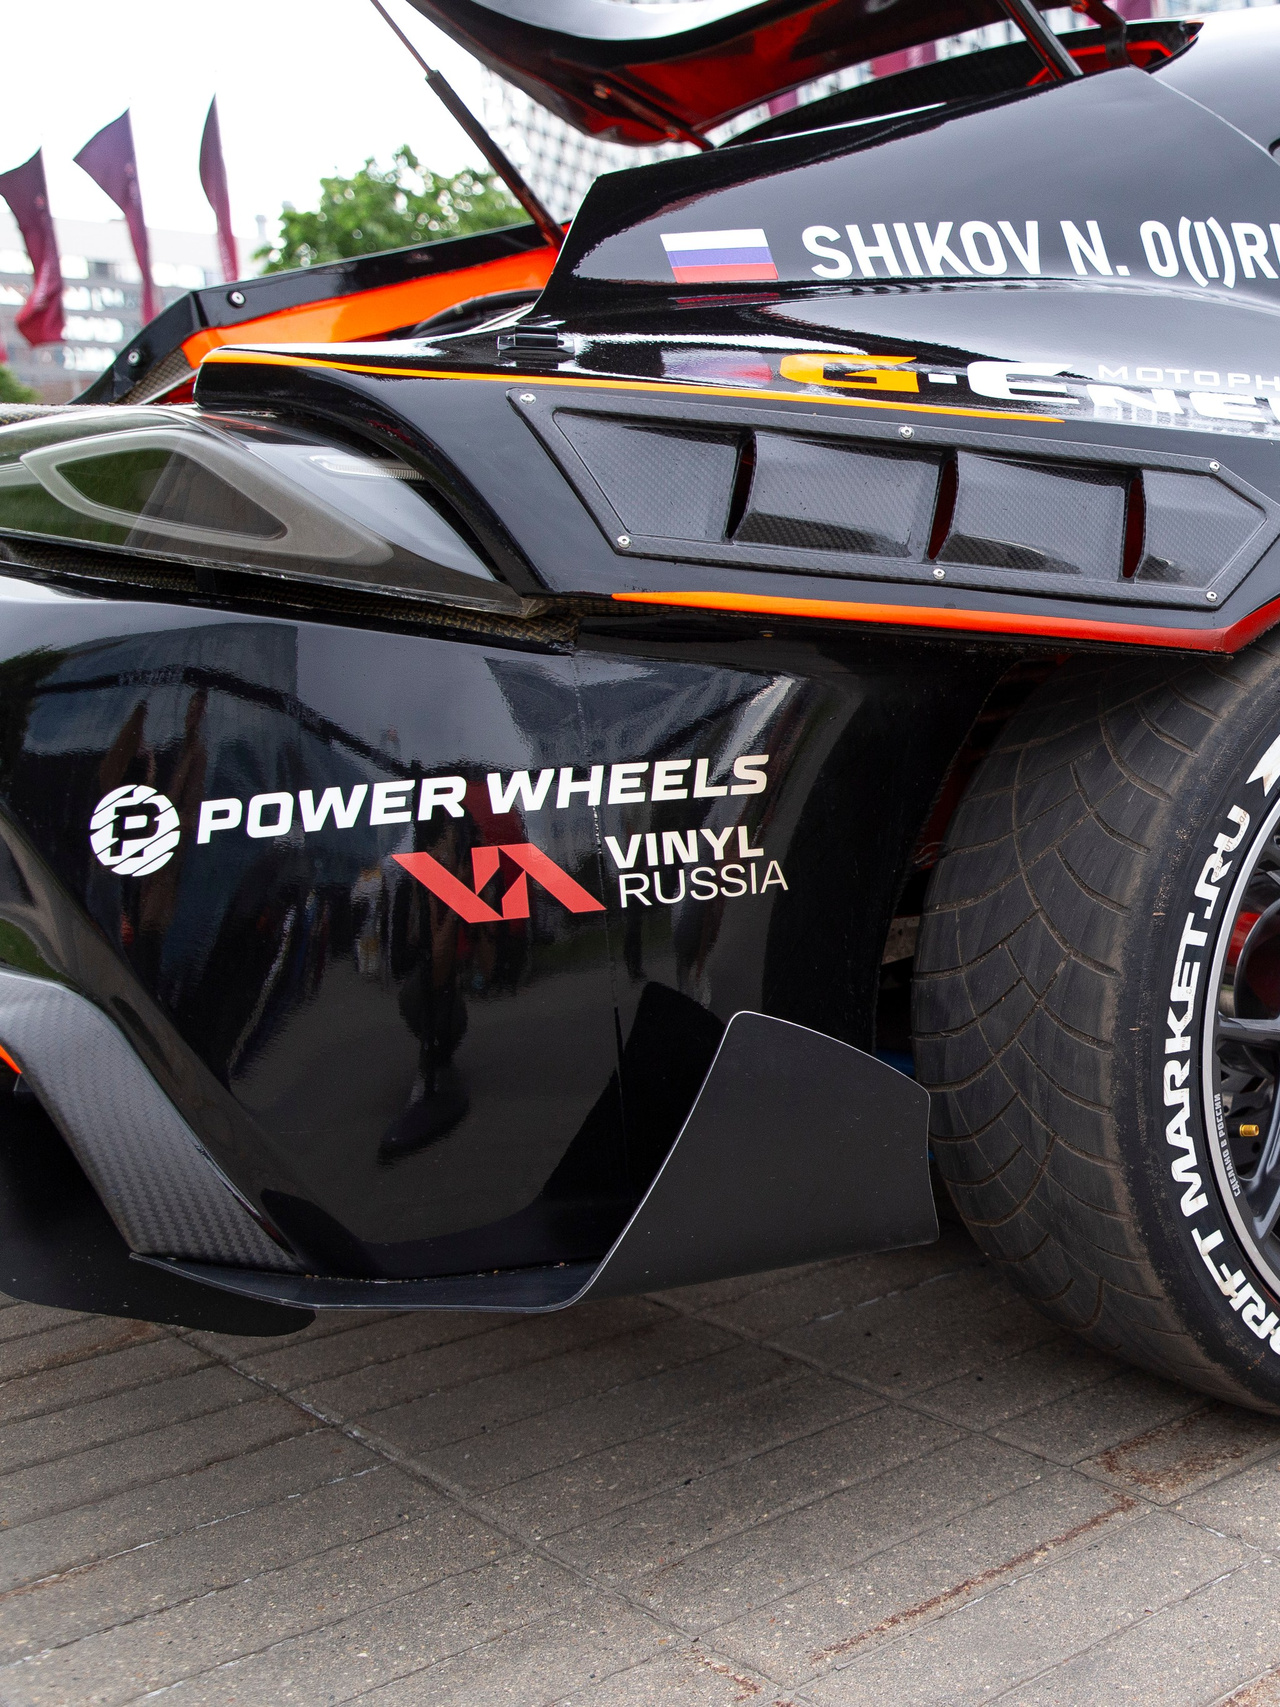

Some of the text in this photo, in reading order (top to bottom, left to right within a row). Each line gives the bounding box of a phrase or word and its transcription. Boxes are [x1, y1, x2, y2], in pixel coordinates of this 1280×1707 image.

[801, 220, 1042, 280] SHIKOV
[1065, 219, 1130, 277] N.
[197, 754, 770, 844] POWER WHEELS
[604, 825, 764, 869] VINYL
[618, 860, 789, 908] RUSSIA
[1213, 1093, 1241, 1197] СДЕЛАНО В РОССИИ
